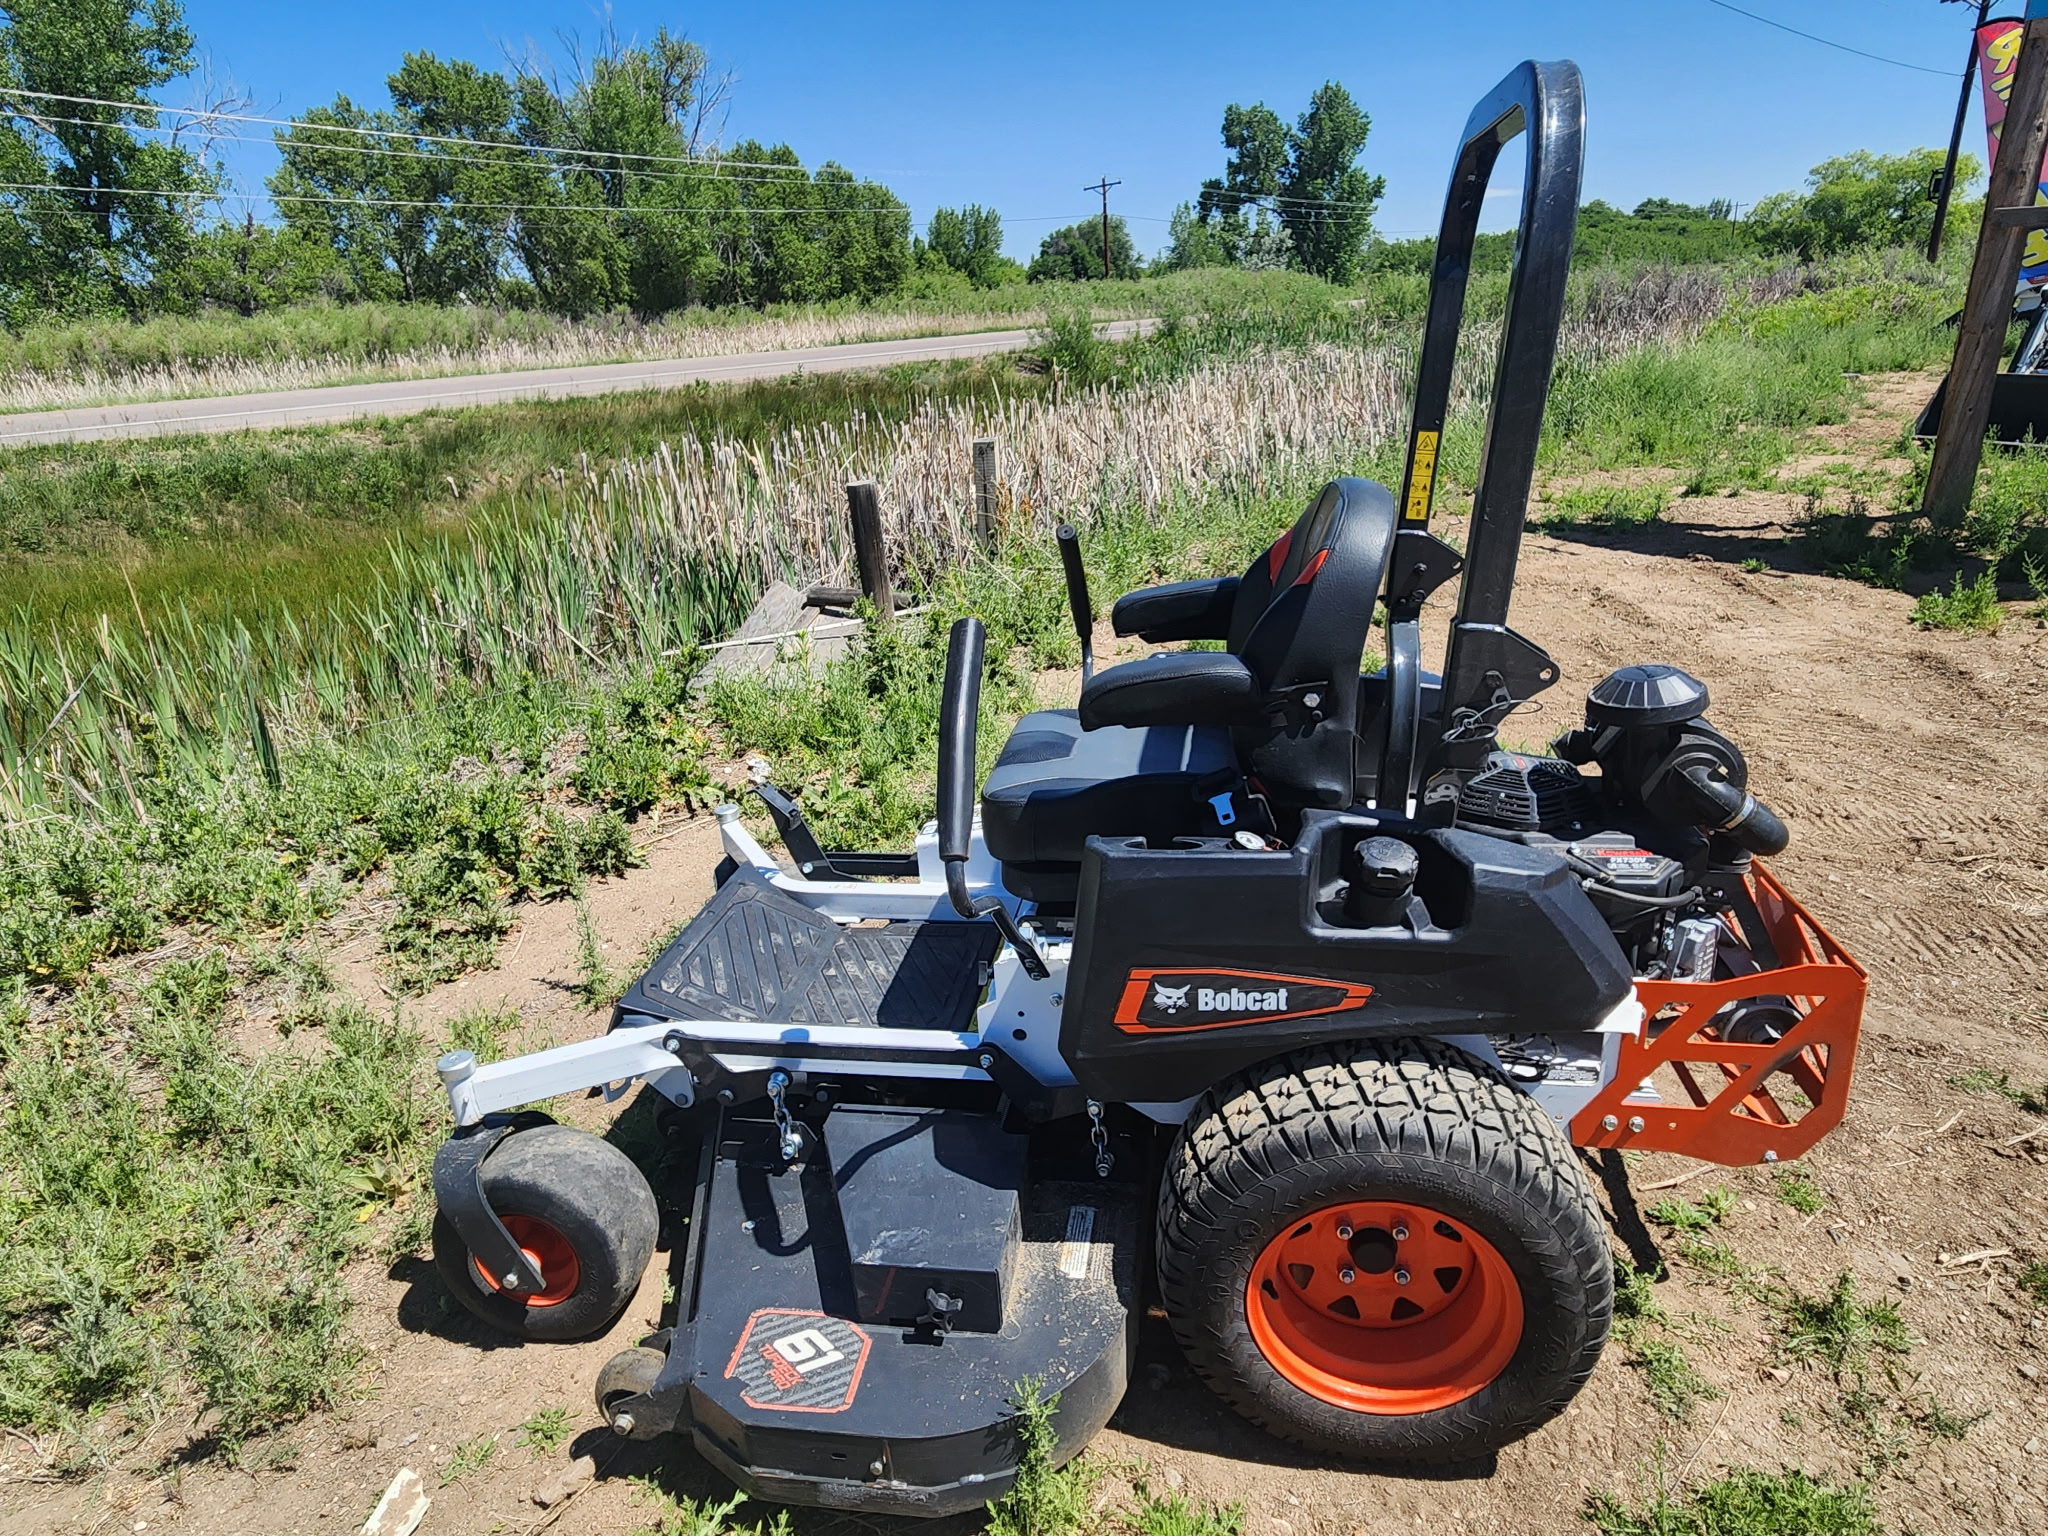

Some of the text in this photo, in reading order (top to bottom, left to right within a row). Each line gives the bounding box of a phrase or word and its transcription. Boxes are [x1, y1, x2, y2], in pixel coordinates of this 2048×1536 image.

[1198, 988, 1288, 1011] Bobcat
[773, 1329, 844, 1373] 61
[764, 1370, 791, 1390] PRO
